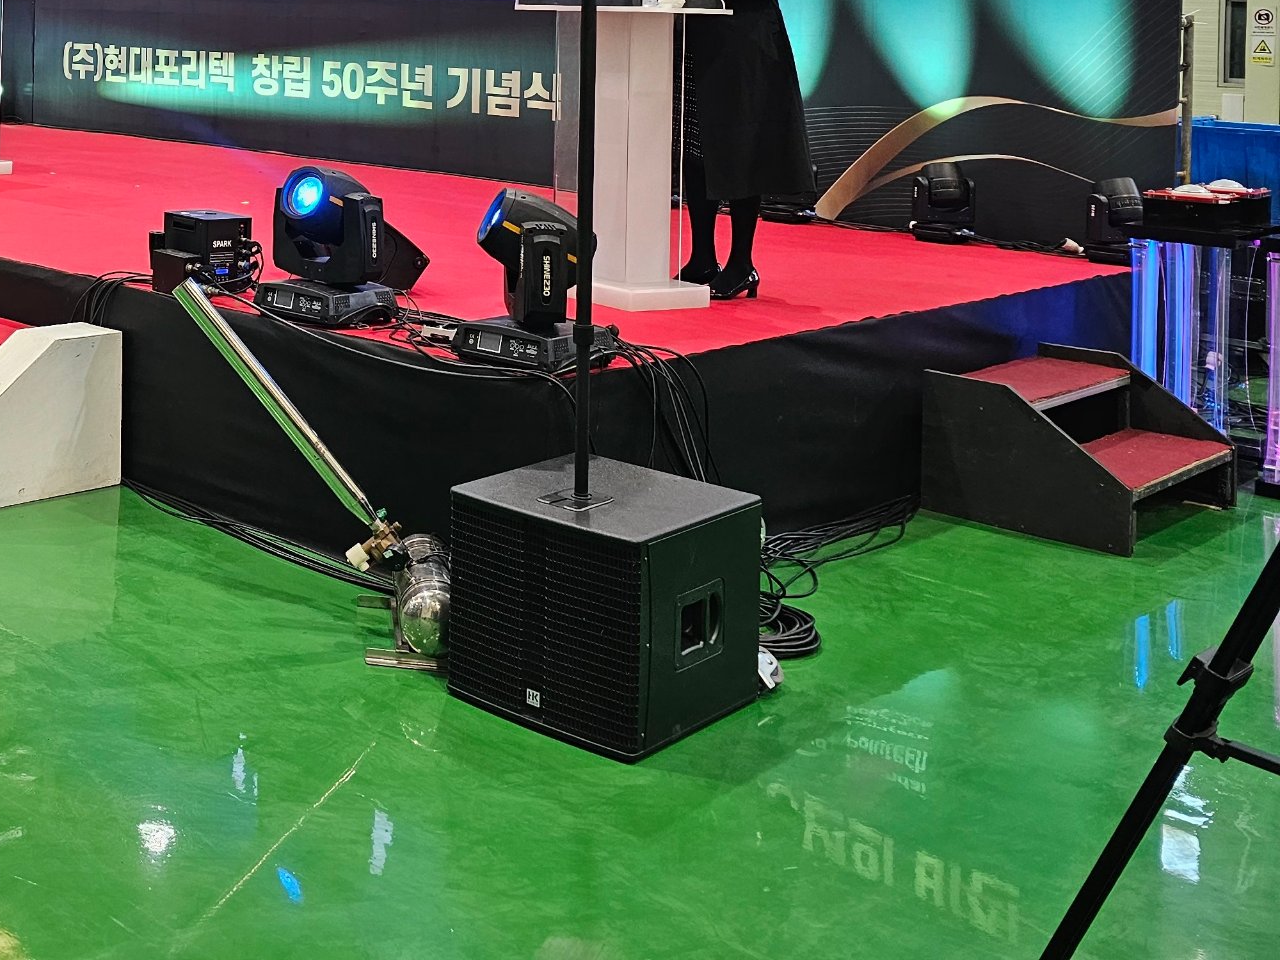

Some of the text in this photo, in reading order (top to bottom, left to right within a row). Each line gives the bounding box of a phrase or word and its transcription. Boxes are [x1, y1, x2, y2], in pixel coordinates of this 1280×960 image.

[63, 41, 562, 122] (주)현대포리텍 창립 50주년 기념식
[212, 240, 232, 249] SPARK
